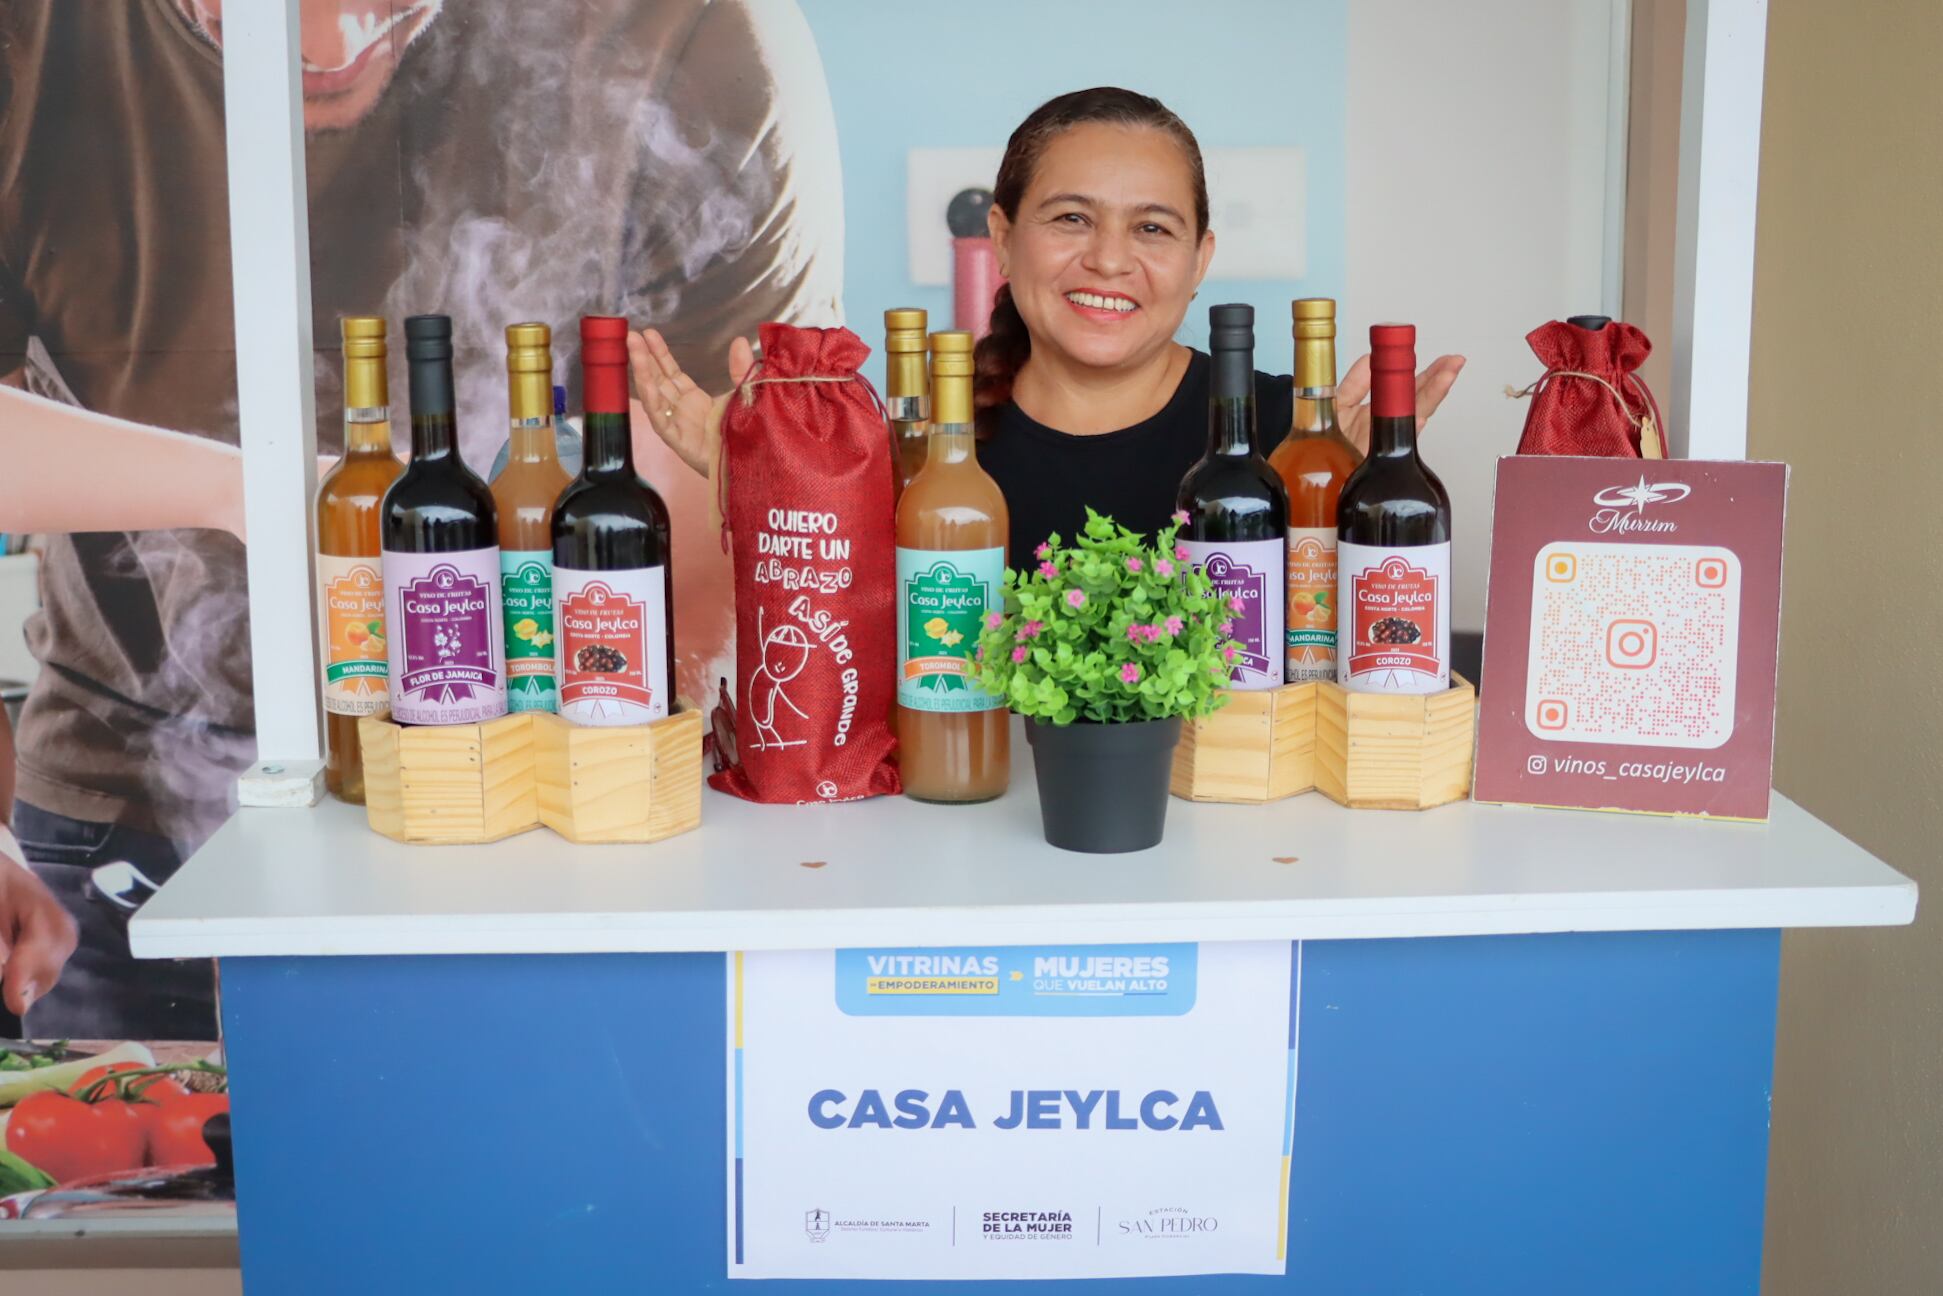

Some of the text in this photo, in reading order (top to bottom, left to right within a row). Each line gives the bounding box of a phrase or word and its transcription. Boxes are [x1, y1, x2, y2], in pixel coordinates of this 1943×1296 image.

[768, 508, 838, 534] QUIERO
[758, 532, 851, 560] DARTE UN
[755, 558, 853, 594] ABRAZO
[330, 597, 358, 610] Casa
[503, 594, 551, 610] asa Jey
[910, 592, 981, 609] Casa Jeylca
[1358, 589, 1432, 606] Casa Jeylca
[407, 599, 484, 616] Casa Jeylca
[565, 615, 638, 633] Casa Jeylca
[788, 595, 849, 642] ASÍ
[512, 663, 553, 672] TOROMBOL
[1376, 657, 1411, 666] COROZO
[410, 671, 483, 686] FLOR DE JAMAICA
[582, 686, 618, 695] COROZO
[1554, 755, 1727, 784] vinos_casajeylca
[867, 956, 999, 976] VITRINAS
[1034, 956, 1169, 977] MUJERES
[878, 980, 994, 990] EMPODERAMIENTO
[1033, 980, 1168, 991] QUE VUELAN ALTO
[807, 1088, 1226, 1131] CASA JEYLCA
[983, 1210, 1072, 1222] SECRETARÍA
[1149, 1207, 1189, 1215] ESTACIÓN
[834, 1219, 869, 1227] ALCALDÍA
[983, 1223, 1072, 1233] DE LA MUJER
[1119, 1217, 1218, 1233] SAN PEDRO
